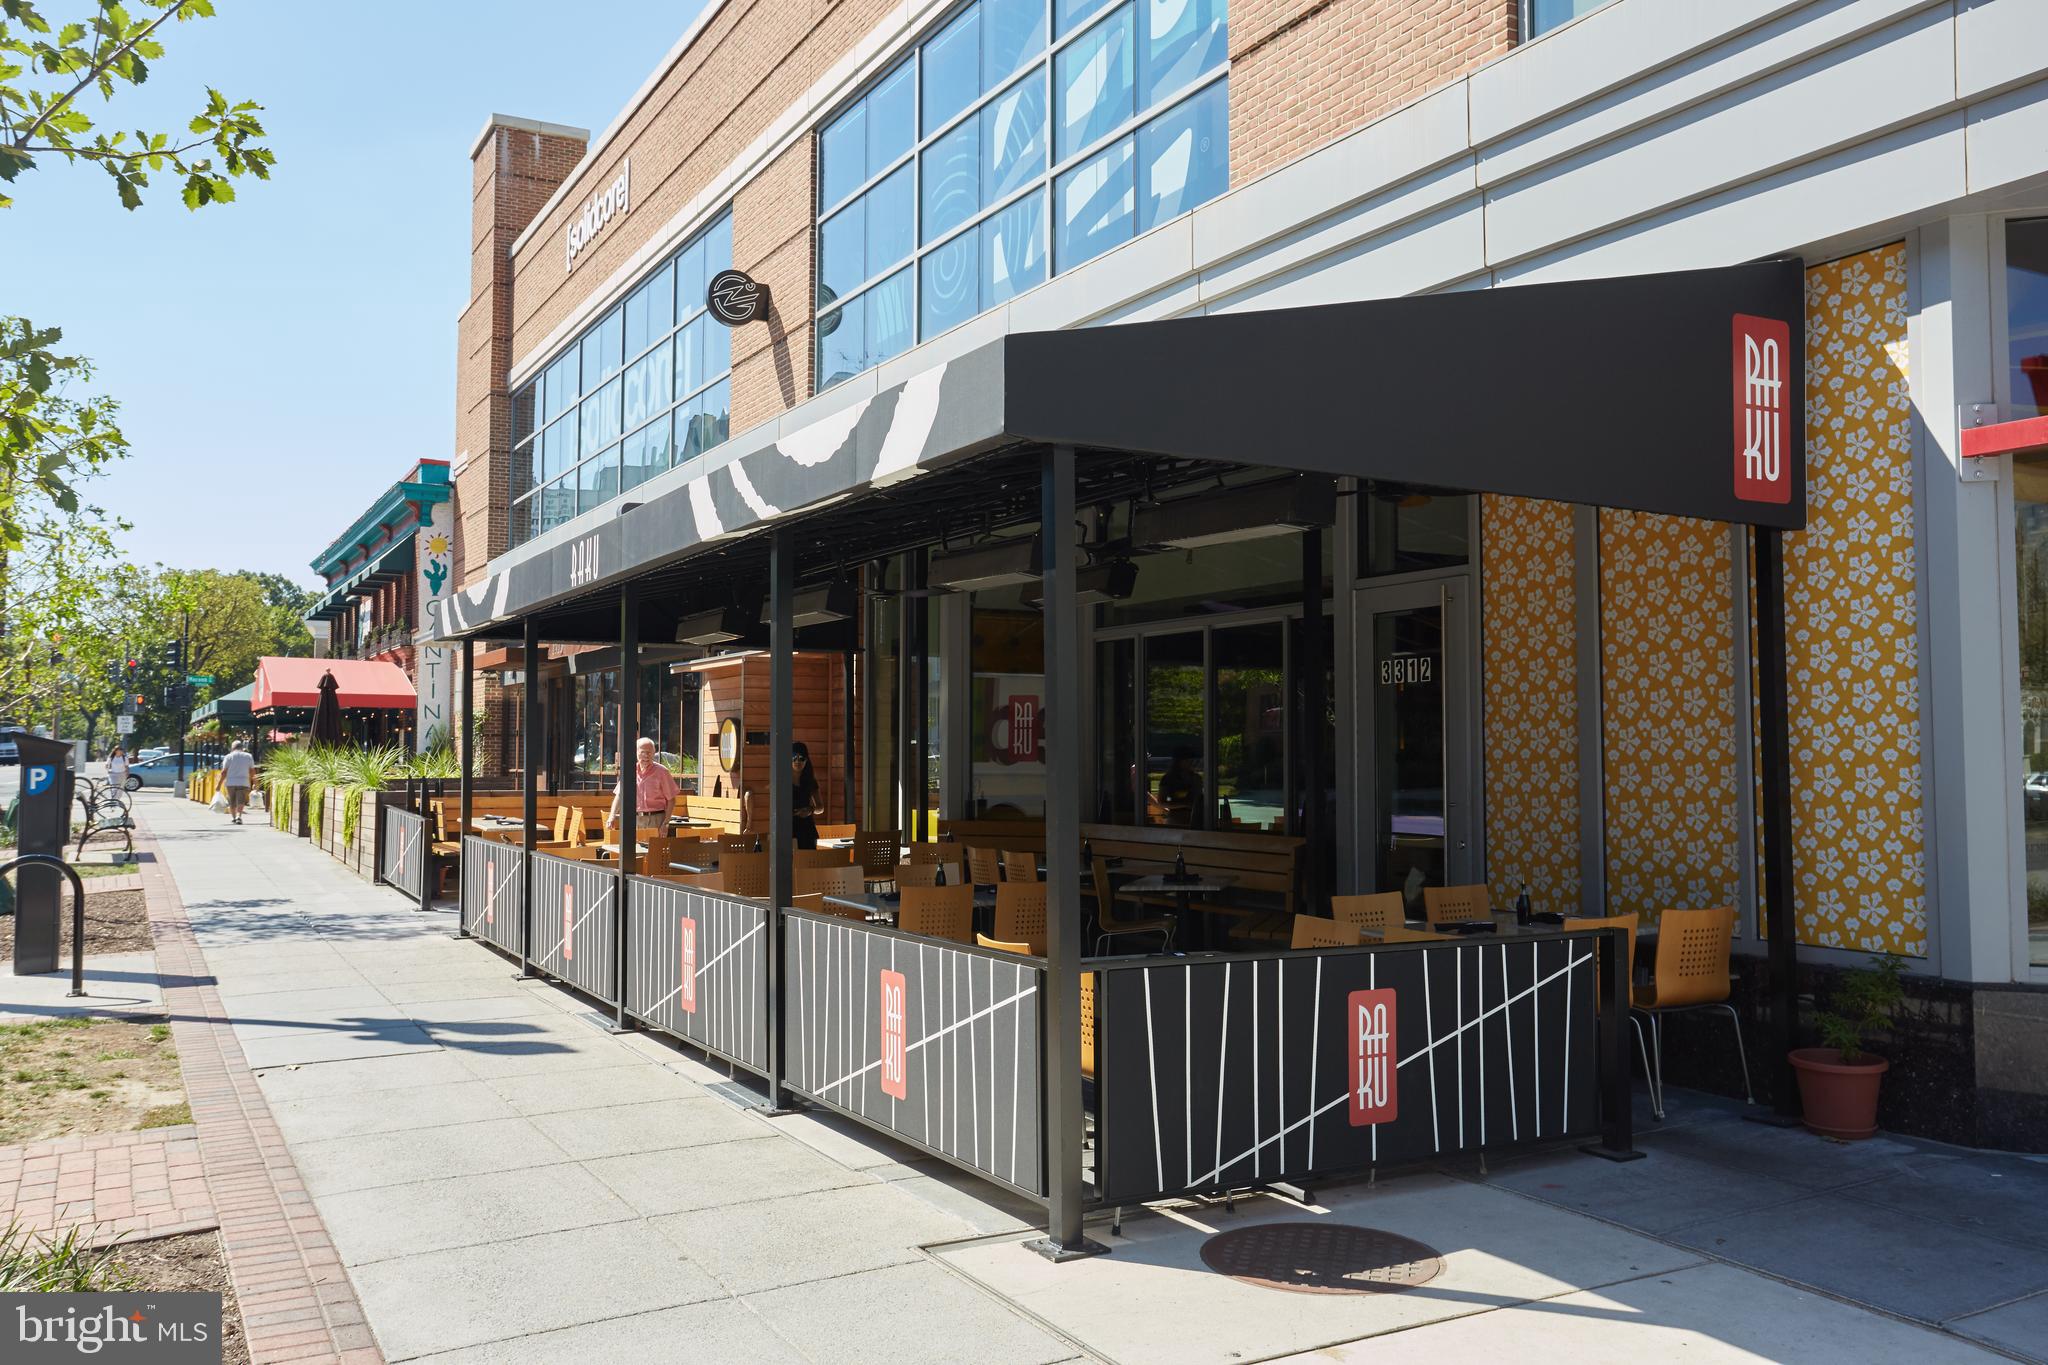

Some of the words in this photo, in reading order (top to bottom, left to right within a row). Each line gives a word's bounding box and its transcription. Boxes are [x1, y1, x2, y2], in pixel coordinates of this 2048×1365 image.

[570, 533, 599, 588] RAKU
[1382, 658, 1430, 683] 3312
[30, 768, 48, 790] P
